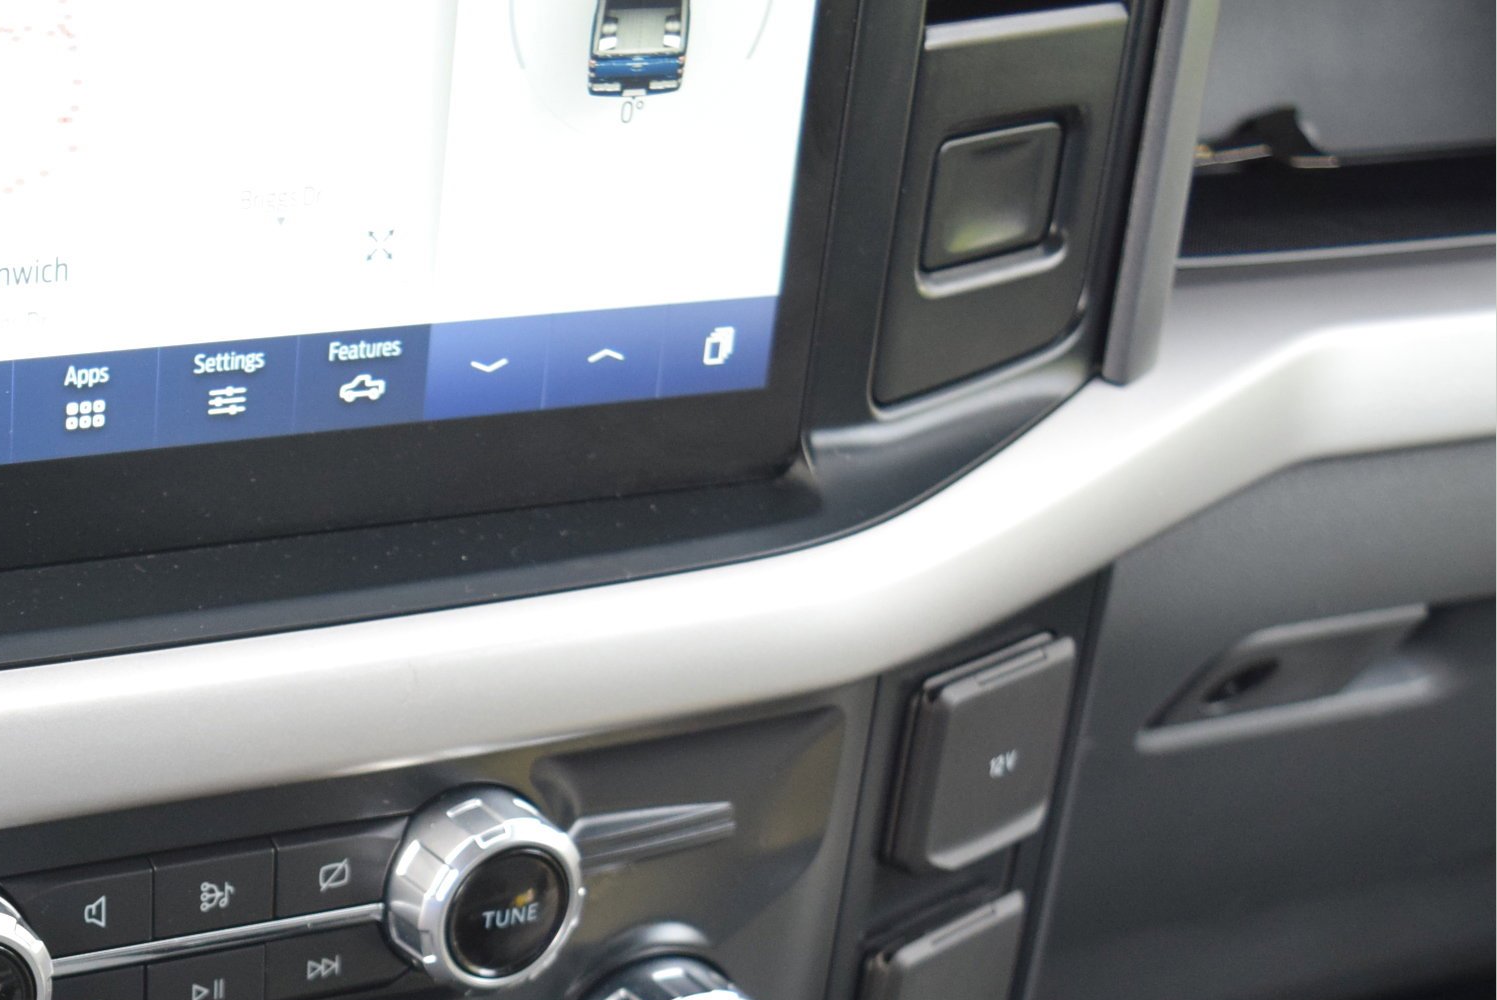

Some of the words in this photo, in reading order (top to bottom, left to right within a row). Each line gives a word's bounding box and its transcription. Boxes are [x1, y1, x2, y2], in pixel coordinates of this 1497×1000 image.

[193, 350, 265, 374] Settings
[328, 340, 402, 362] Features
[63, 365, 110, 389] Apps
[482, 904, 538, 928] TUNE
